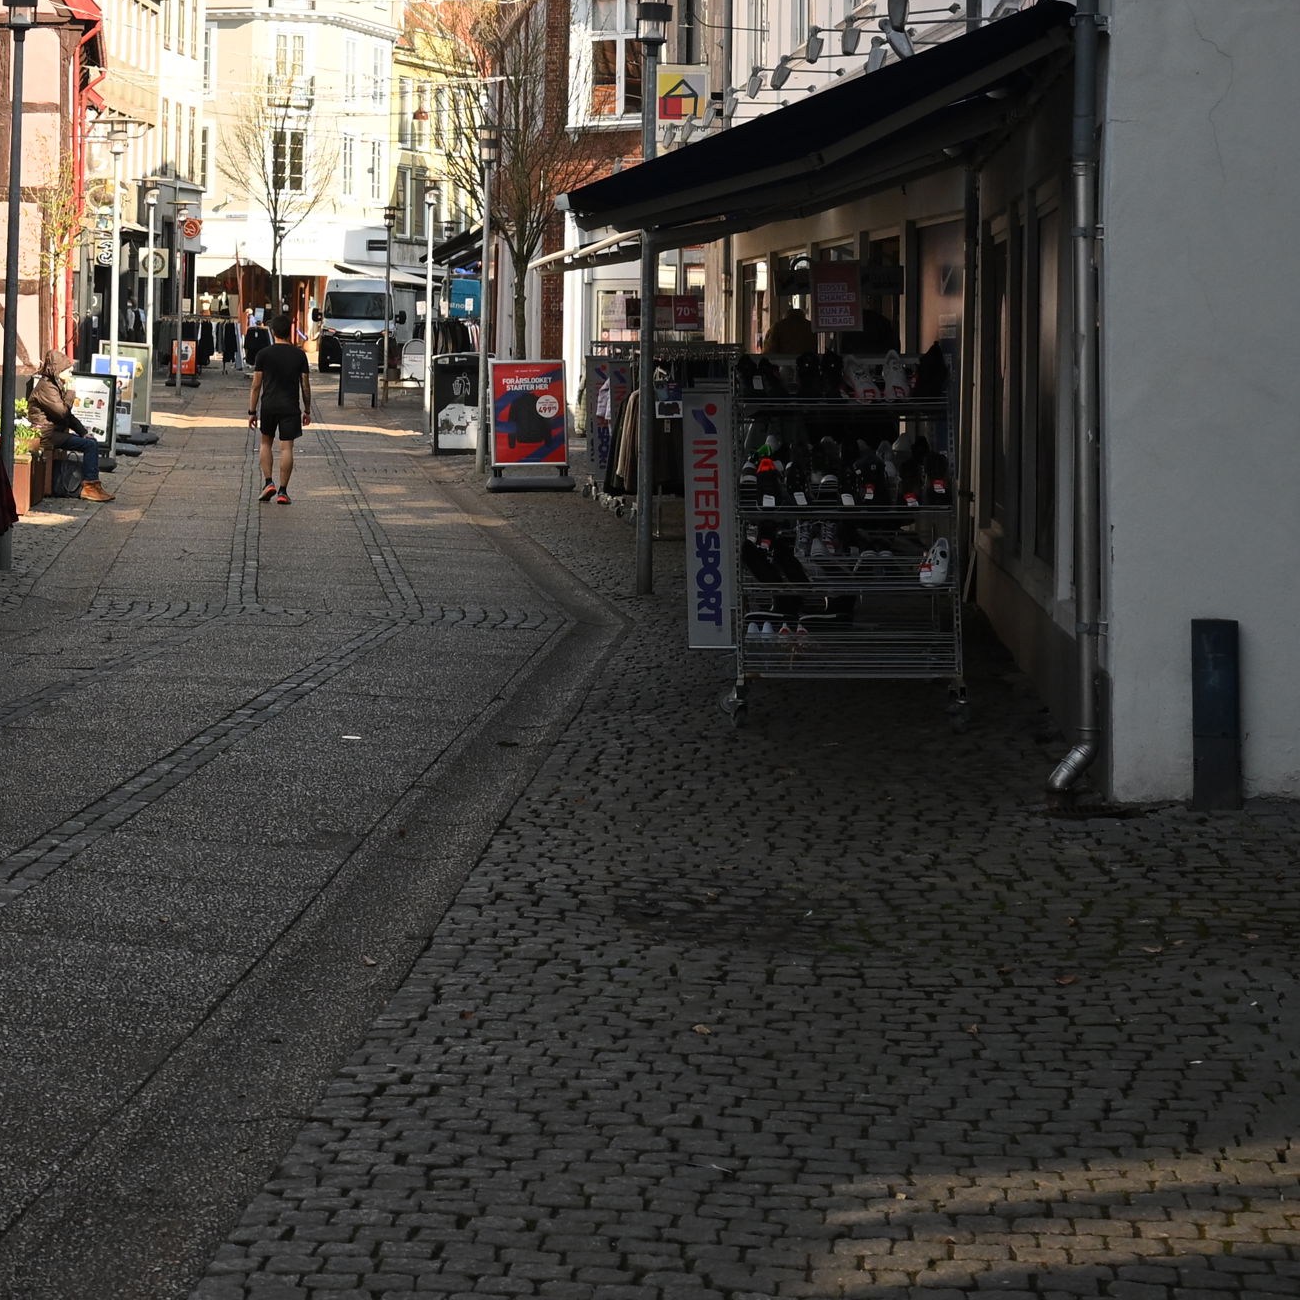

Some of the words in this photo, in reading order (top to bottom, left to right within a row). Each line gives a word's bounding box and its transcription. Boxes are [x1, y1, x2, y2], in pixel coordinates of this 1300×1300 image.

[676, 306, 697, 317] 70%
[819, 307, 837, 315] KUN
[820, 317, 854, 325] TILBAGE
[502, 376, 552, 385] FORÅRSLOOKET
[506, 384, 534, 392] STARTER
[692, 439, 722, 626] INTERSPORT
